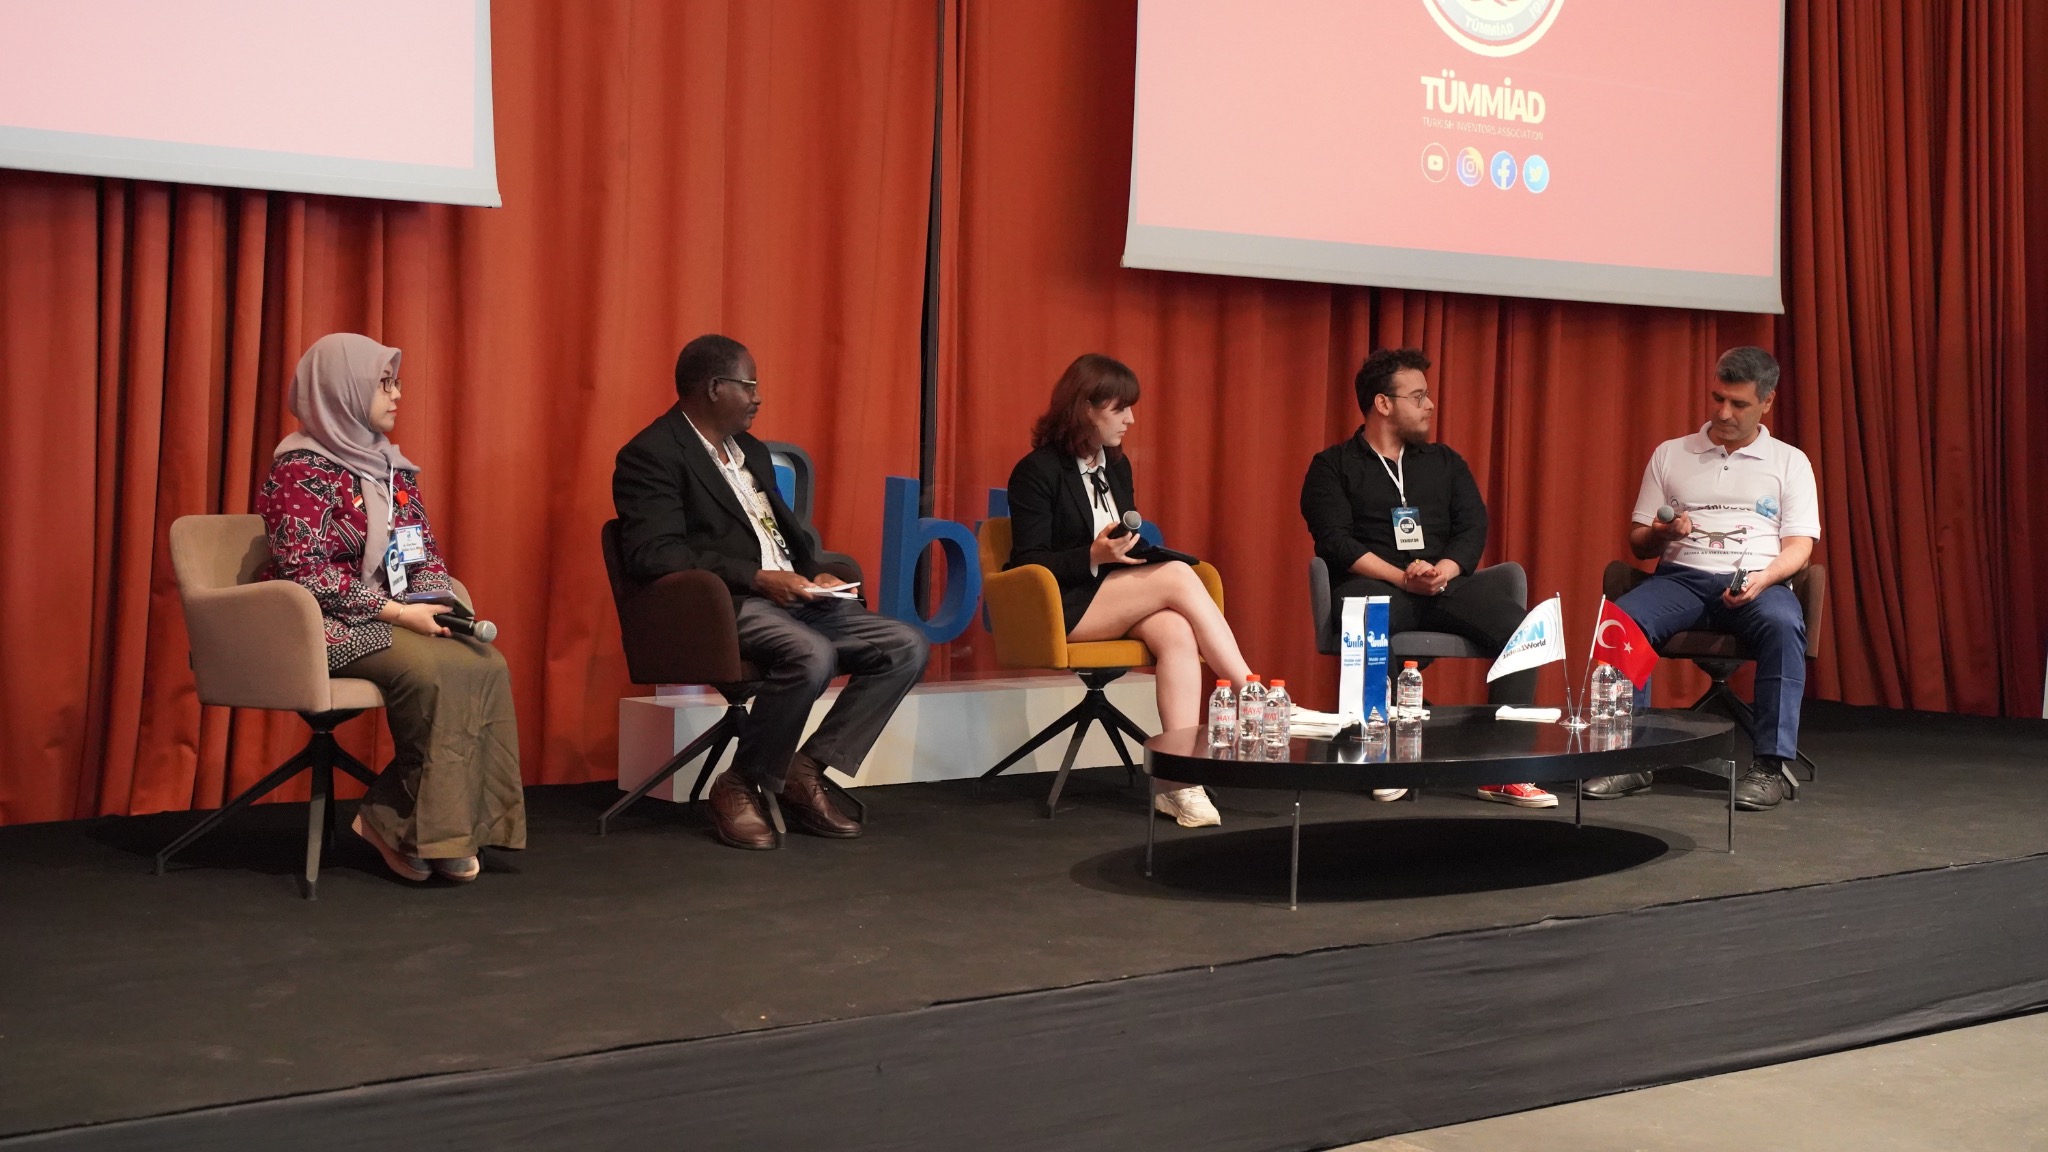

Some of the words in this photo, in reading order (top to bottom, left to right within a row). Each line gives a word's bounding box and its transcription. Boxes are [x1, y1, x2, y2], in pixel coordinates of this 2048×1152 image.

[1420, 68, 1546, 124] TÜMMİAD
[1422, 117, 1455, 129] TURKISH
[1456, 120, 1497, 136] INVENTORS
[1497, 127, 1544, 141] ASSOCIATION
